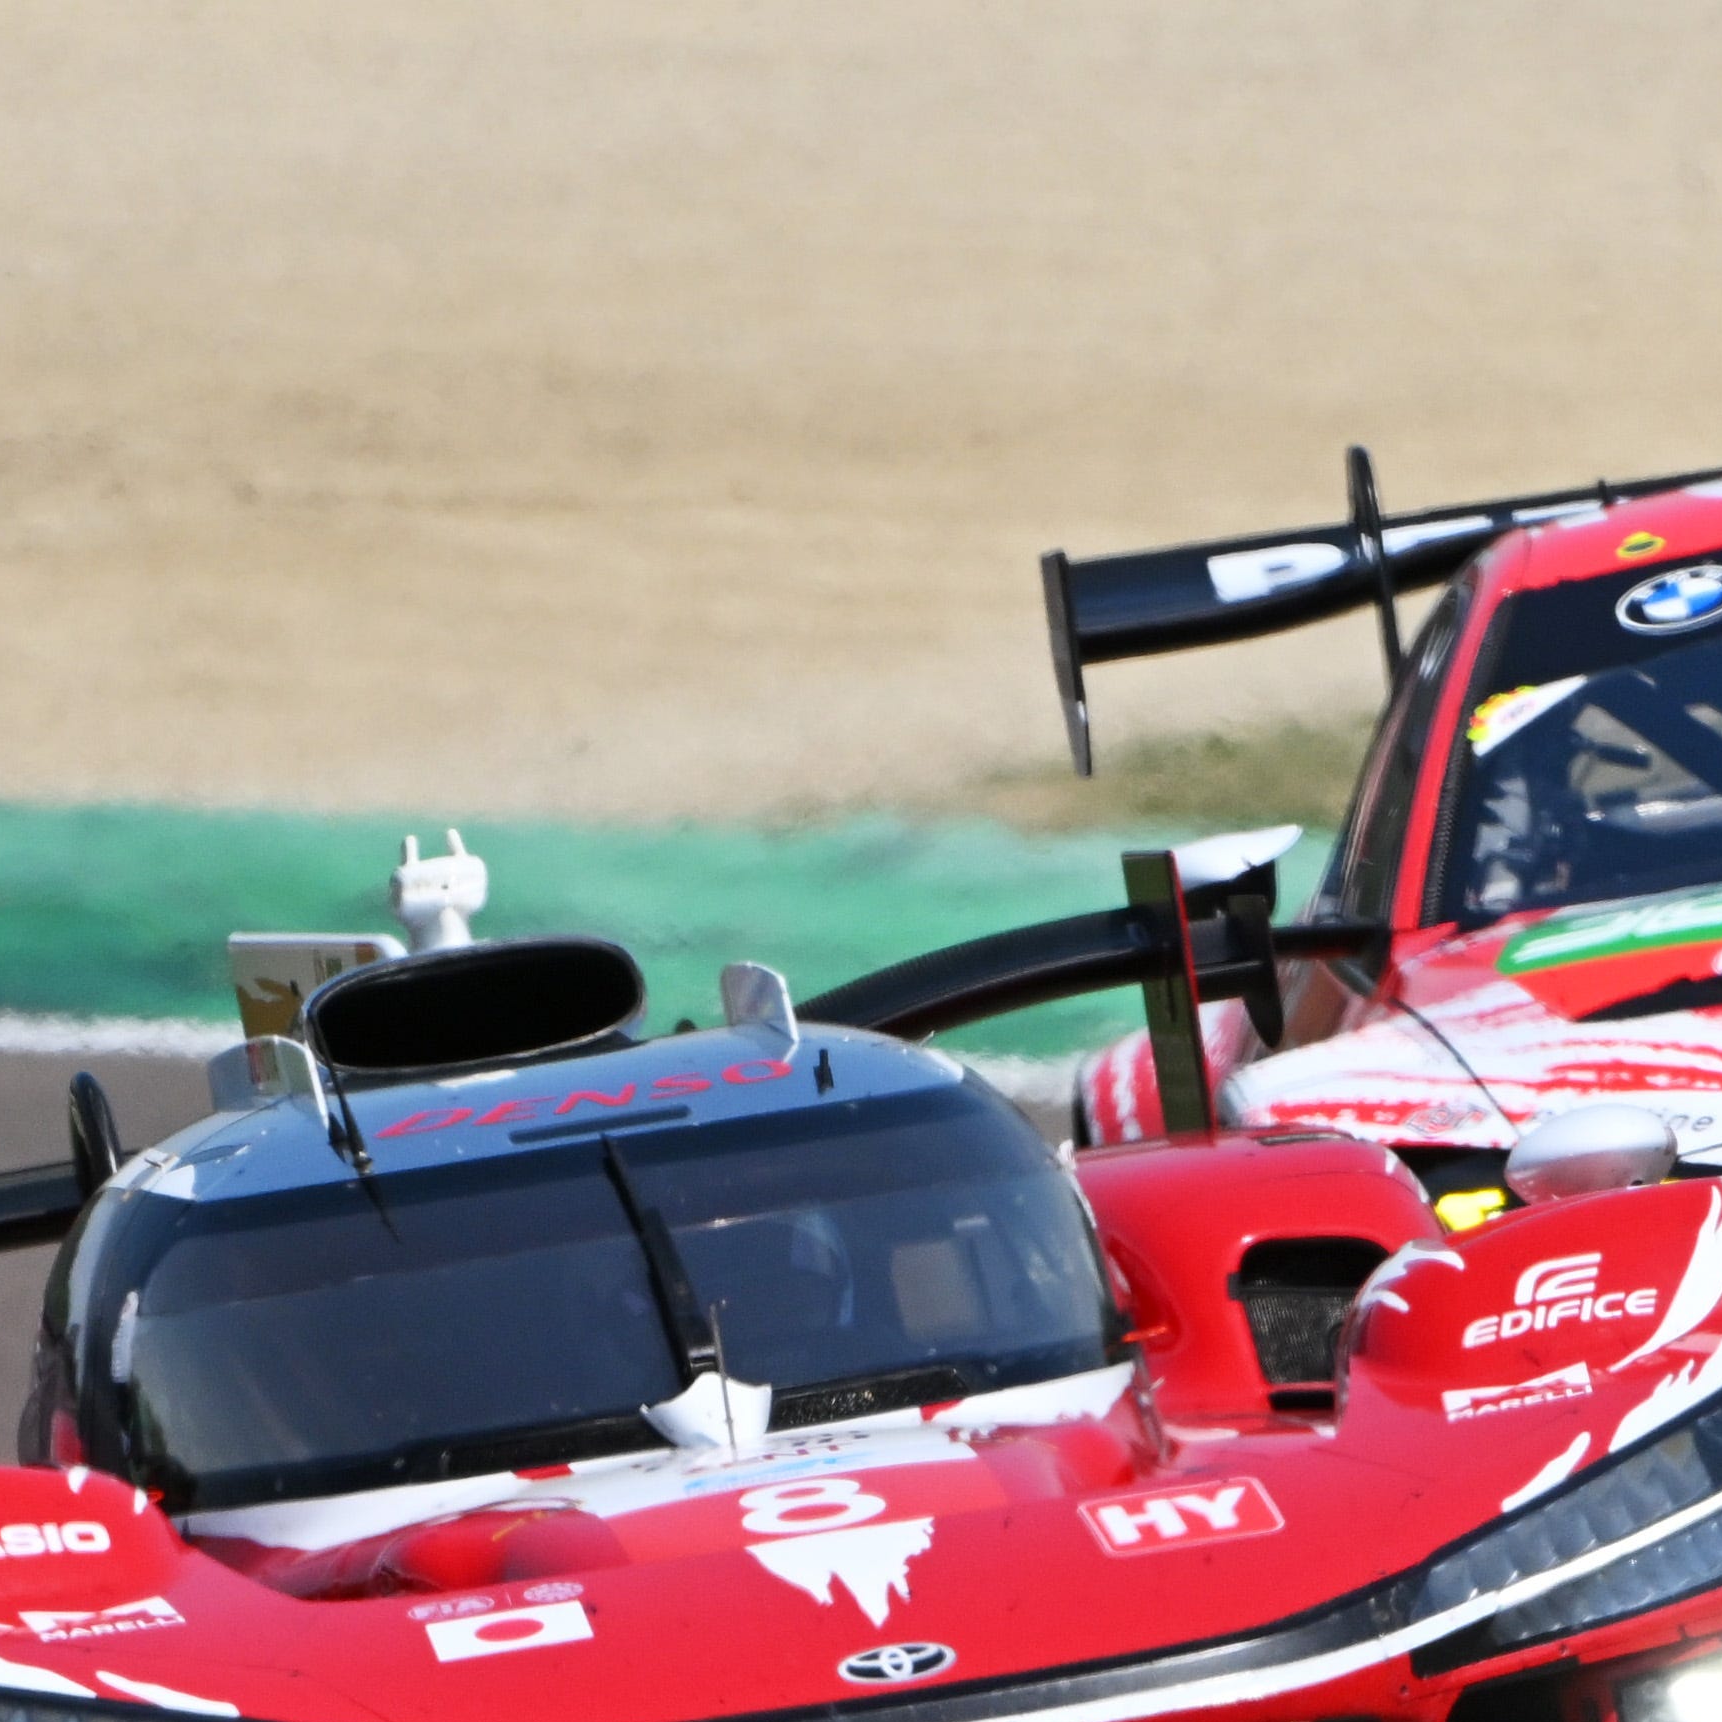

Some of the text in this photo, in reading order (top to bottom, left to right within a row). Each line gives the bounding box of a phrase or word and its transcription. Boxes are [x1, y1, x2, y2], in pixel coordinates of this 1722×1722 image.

[374, 1058, 796, 1139] DENSO
[1460, 1286, 1659, 1349] EDIFICE
[1445, 1383, 1594, 1424] MARELLI
[739, 1478, 888, 1533] 8
[1095, 1486, 1245, 1546] HY
[38, 1614, 186, 1643] MARELLI
